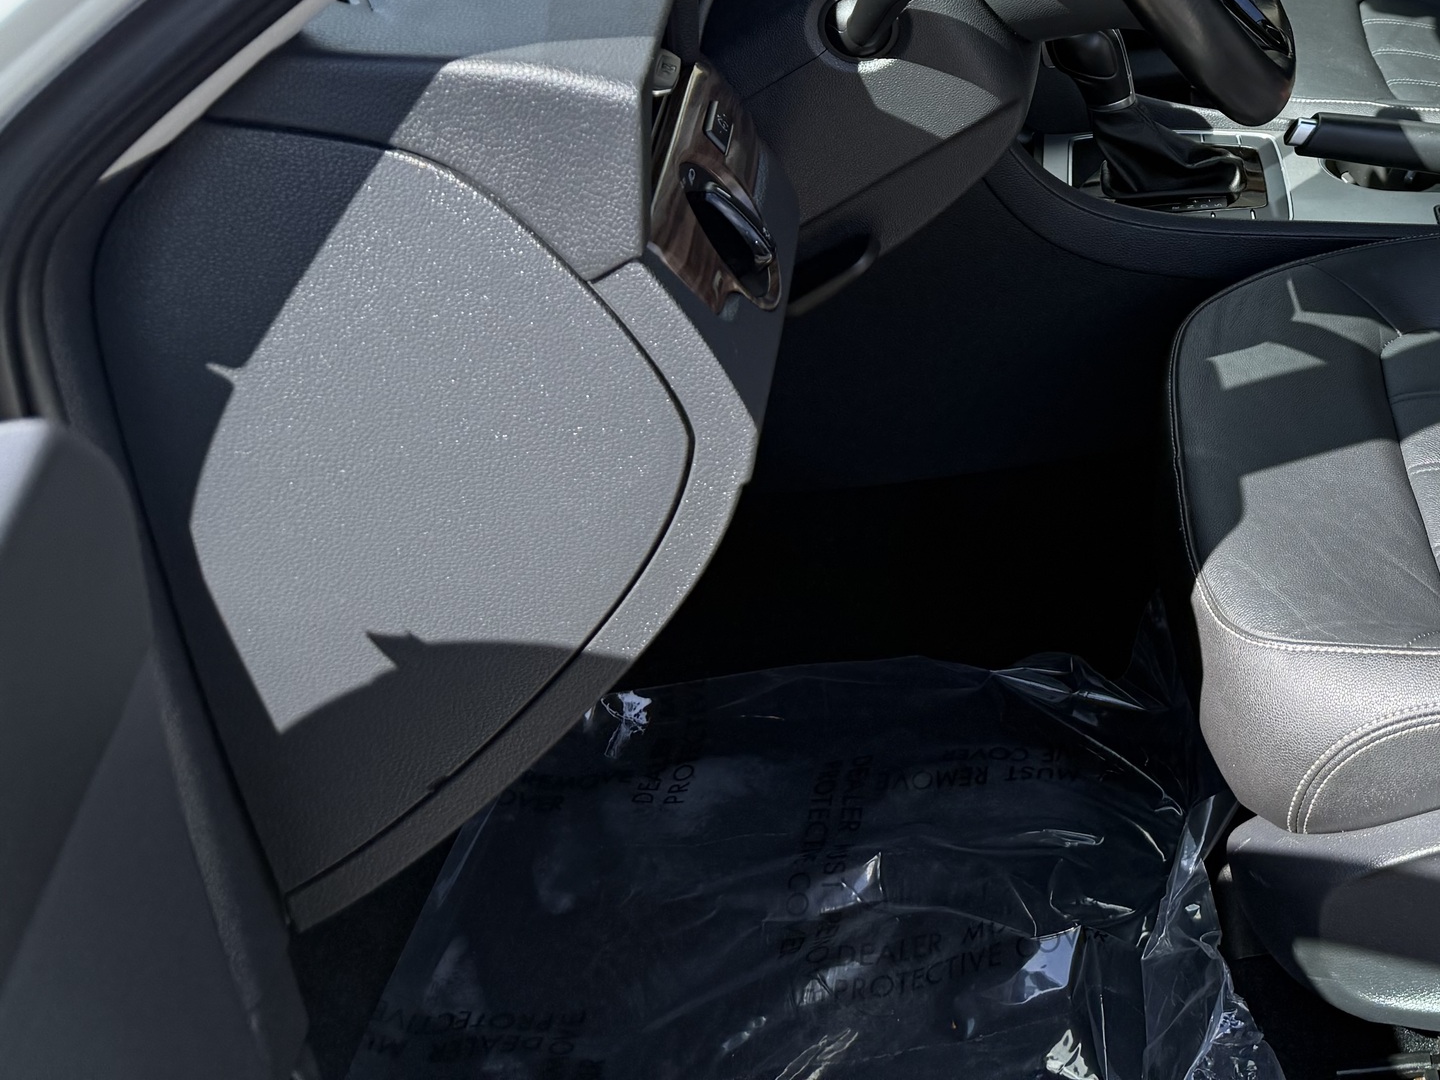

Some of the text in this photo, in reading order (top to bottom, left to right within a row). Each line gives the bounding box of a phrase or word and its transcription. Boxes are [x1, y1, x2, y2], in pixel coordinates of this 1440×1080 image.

[942, 746, 1028, 761] COVER
[874, 766, 987, 789] REMOVE
[501, 790, 564, 811] OVER
[836, 931, 944, 966] DEALER
[830, 941, 1004, 1002] PROTECTIVE
